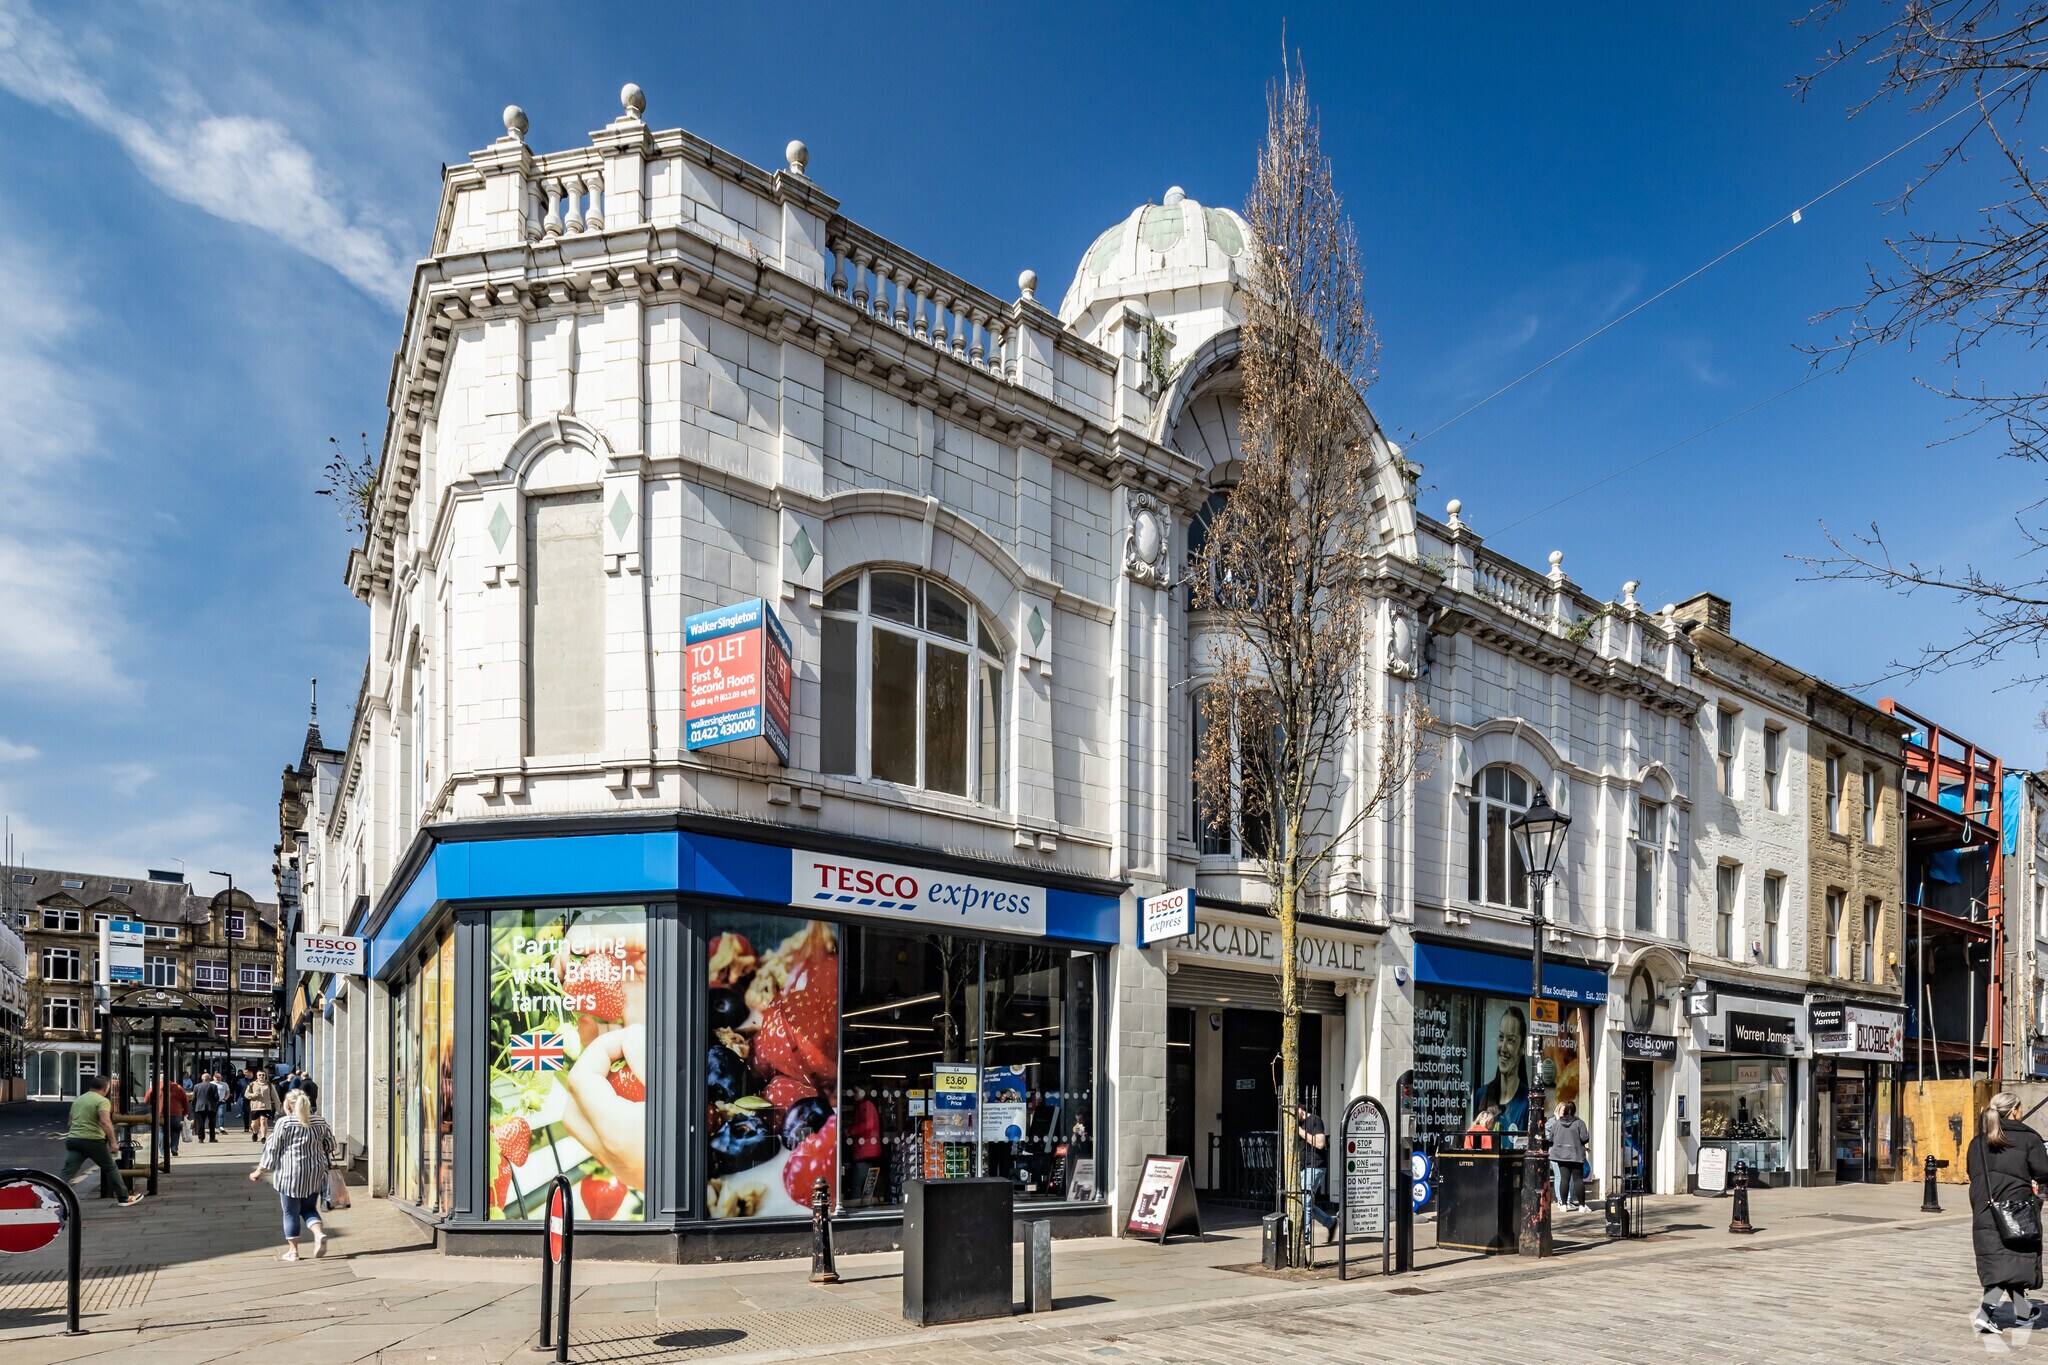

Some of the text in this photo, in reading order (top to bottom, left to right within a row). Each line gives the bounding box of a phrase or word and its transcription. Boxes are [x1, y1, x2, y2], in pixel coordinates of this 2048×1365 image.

[690, 611, 757, 636] WalkerSingleton
[691, 636, 746, 668] TO LET
[768, 637, 777, 665] TO
[777, 652, 787, 682] LET
[692, 666, 722, 685] First &
[691, 673, 755, 697] Second Floors
[691, 707, 756, 730] walkersingleton.co.uk
[691, 726, 719, 743] 01422
[720, 718, 756, 737] 430000
[813, 863, 1030, 915] TESCO express
[1149, 895, 1183, 915] TESCO
[123, 924, 130, 932] 8
[1150, 916, 1182, 933] express
[304, 938, 357, 951] TESCO
[513, 935, 627, 960] Partnering
[1175, 920, 1365, 971] ARCADE OYALE
[307, 955, 355, 967] express
[512, 960, 635, 984] with British
[512, 991, 597, 1013] farmers
[1553, 986, 1579, 999] Southgate
[1585, 991, 1595, 1000] Est.
[1596, 992, 1608, 1002] 2023
[1813, 1009, 1841, 1018] Warren
[1815, 1017, 1839, 1026] James
[1626, 1034, 1675, 1051] Get Brown
[1735, 1024, 1765, 1041] Warren
[1766, 1027, 1791, 1044] James
[1414, 1042, 1467, 1059] Southgate's
[1543, 1037, 1578, 1051] you today
[1413, 1061, 1462, 1075] customers,
[1740, 1070, 1758, 1078] SALE
[946, 1076, 968, 1085] £3.60
[1413, 1079, 1470, 1091] communities
[1412, 1095, 1467, 1111] and planet a
[1353, 1106, 1379, 1119] CAUTION
[1414, 1112, 1463, 1125] ittle better
[1358, 1177, 1370, 1185] NOT
